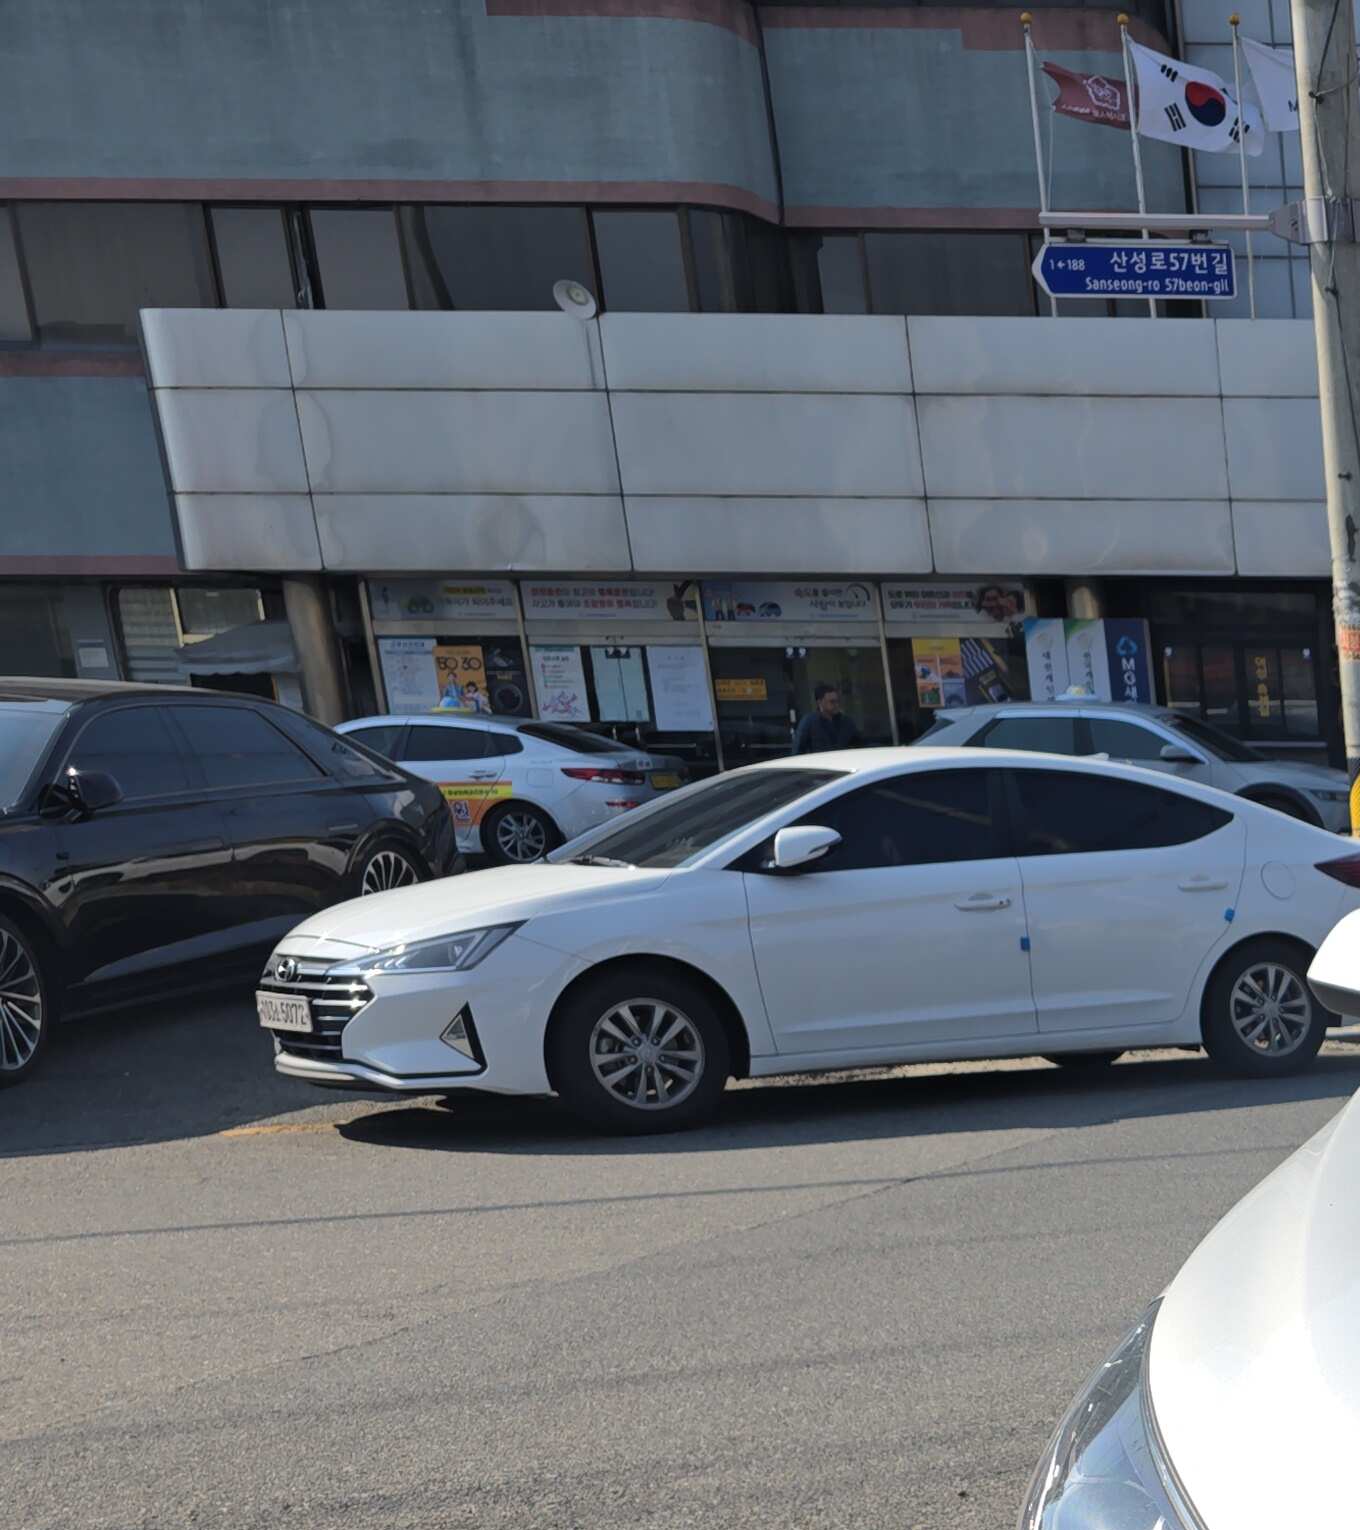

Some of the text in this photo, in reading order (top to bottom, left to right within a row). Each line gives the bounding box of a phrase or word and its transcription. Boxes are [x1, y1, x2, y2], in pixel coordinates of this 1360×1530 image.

[1067, 259, 1086, 271] 188
[1110, 251, 1228, 275] 산성로57번길
[1086, 277, 1230, 294] Sanseong-ro 57beon-gil
